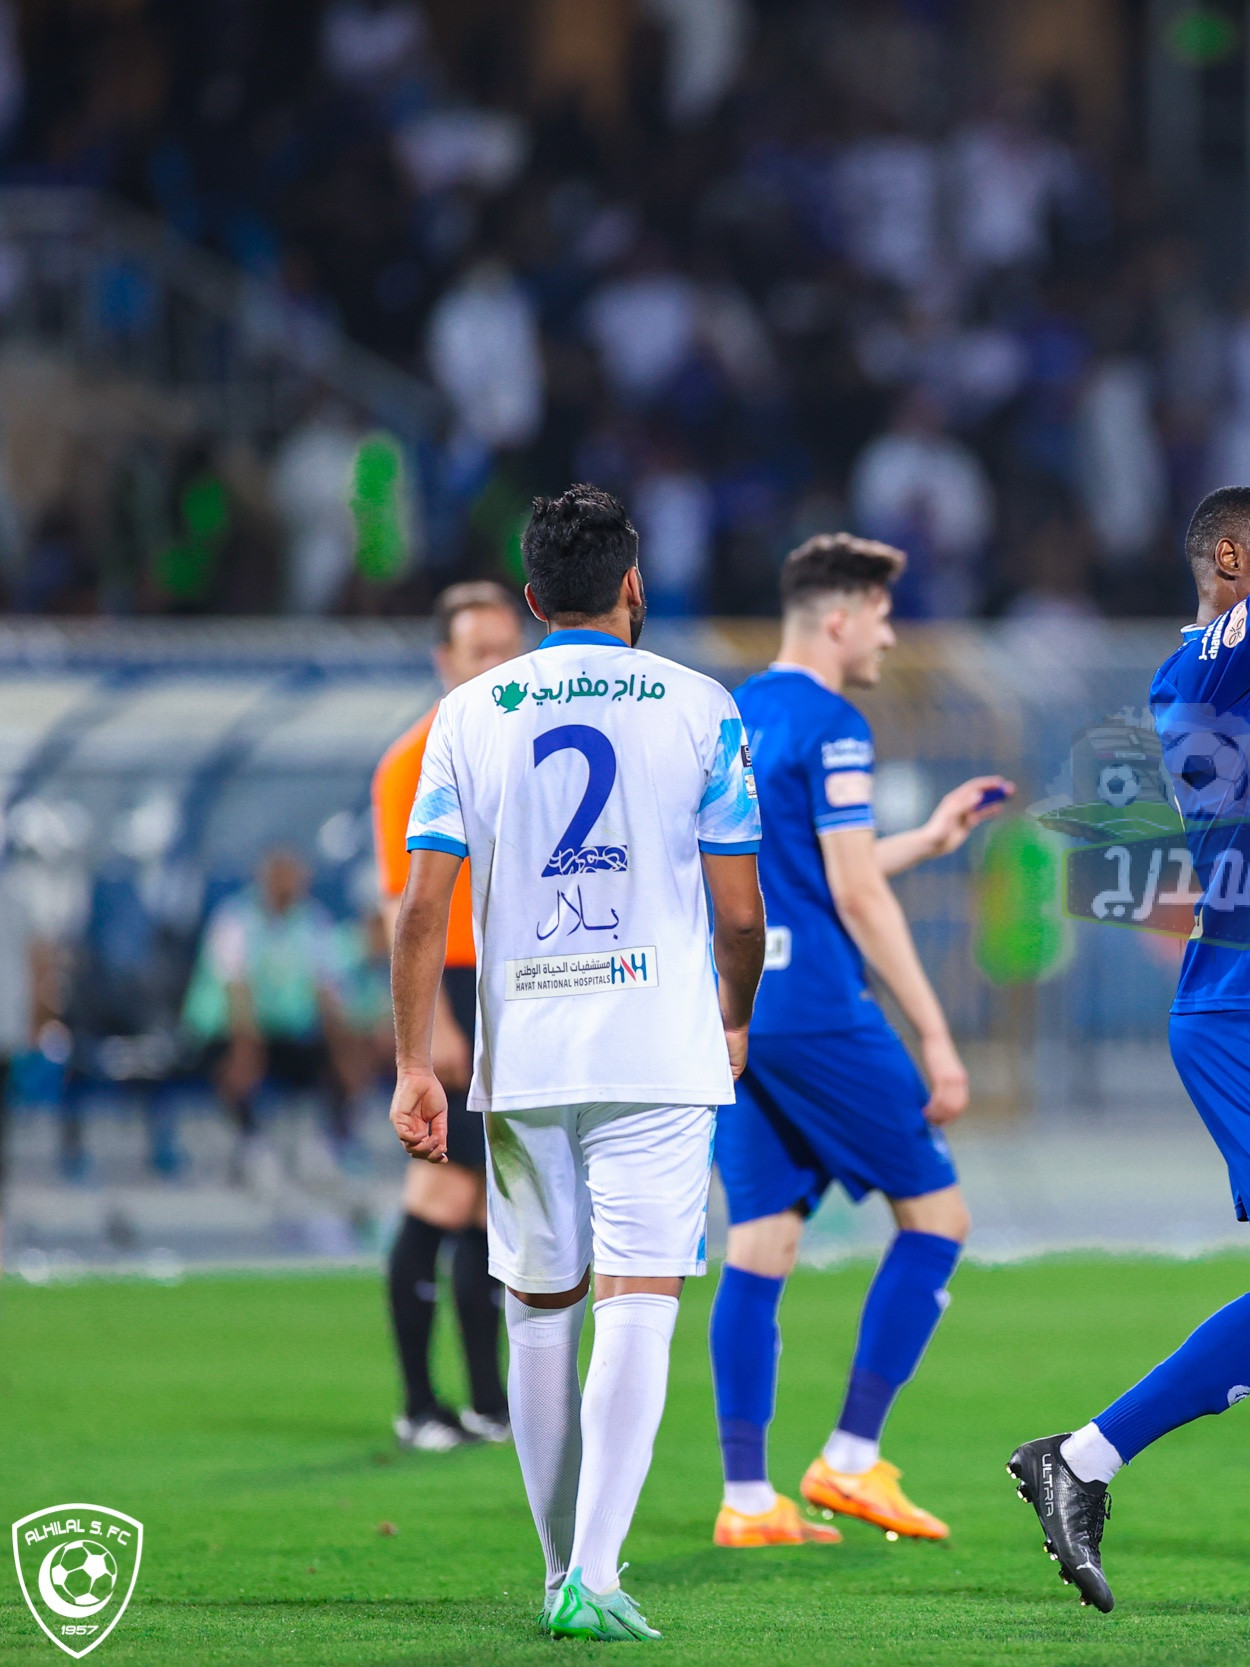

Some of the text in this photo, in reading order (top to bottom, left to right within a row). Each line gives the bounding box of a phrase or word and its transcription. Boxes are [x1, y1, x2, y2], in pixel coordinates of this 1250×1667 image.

[531, 671, 666, 706] مزاج مغربي
[533, 724, 628, 878] 2
[536, 884, 620, 941] بلال
[515, 959, 611, 981] مستشفيات الحياة الوطني
[515, 974, 611, 992] HAYAT NATIONAL HOSPITALS
[1042, 1453, 1054, 1517] ULTRA
